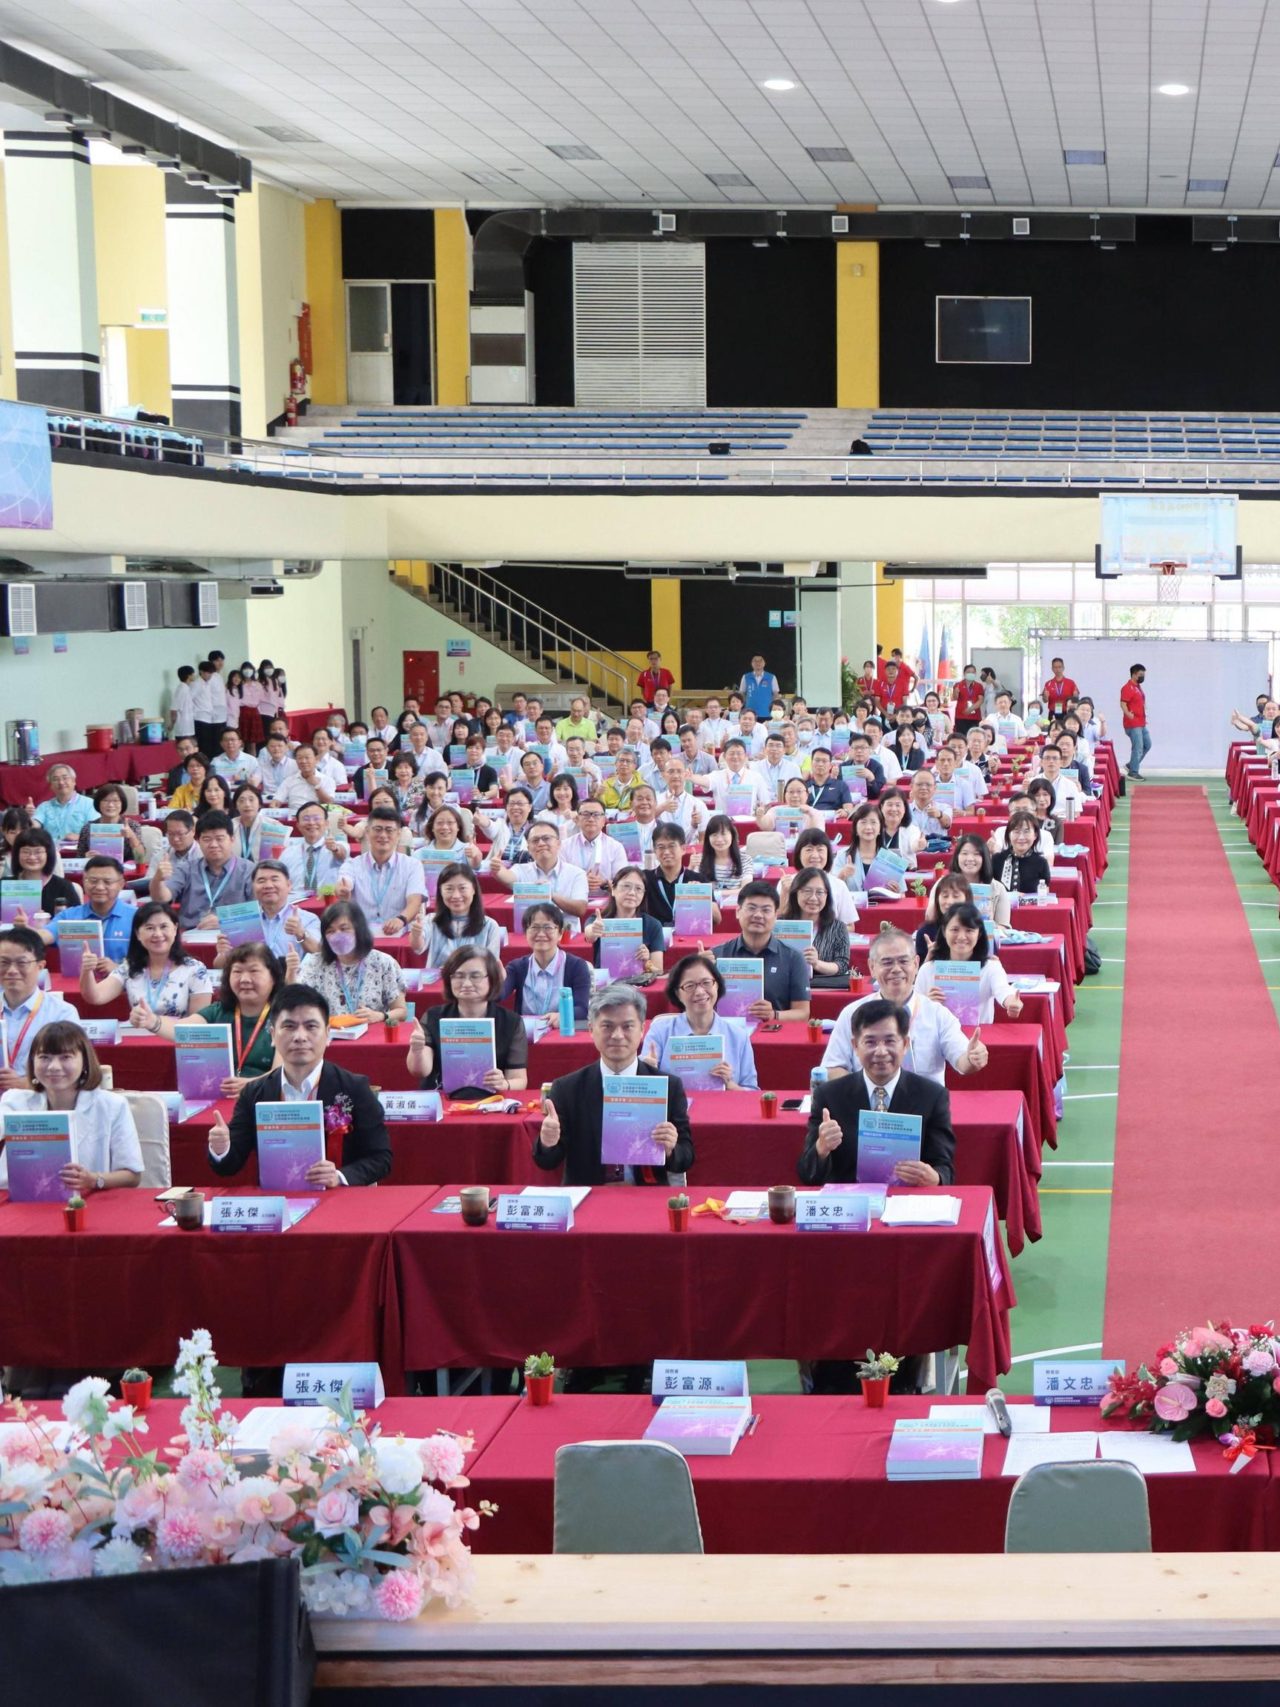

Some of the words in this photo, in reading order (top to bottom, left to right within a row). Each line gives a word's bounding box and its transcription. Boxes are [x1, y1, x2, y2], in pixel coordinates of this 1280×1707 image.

[221, 1207, 258, 1218] 張永傑
[507, 1205, 544, 1217] 彭富源
[806, 1205, 843, 1217] 潘文忠
[295, 1379, 344, 1394] 張永傑
[665, 1376, 712, 1391] 彭富源
[1046, 1376, 1093, 1391] 潘文忠
